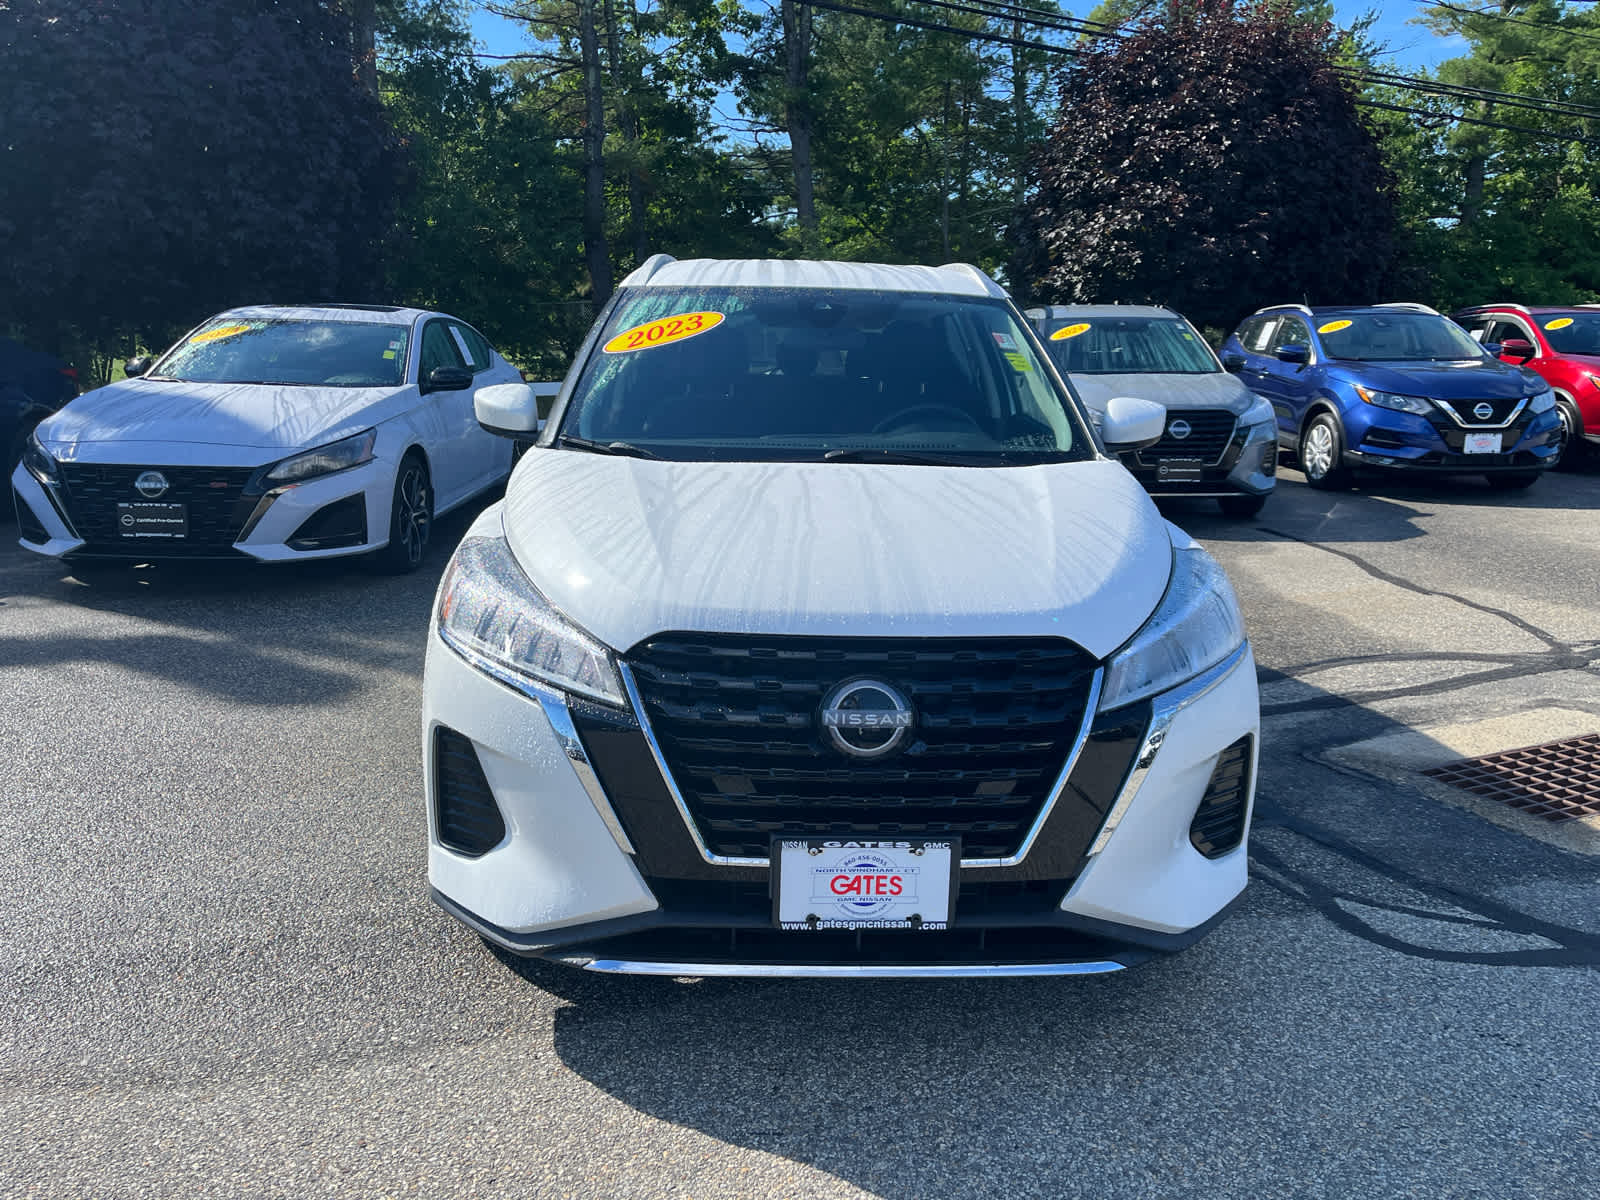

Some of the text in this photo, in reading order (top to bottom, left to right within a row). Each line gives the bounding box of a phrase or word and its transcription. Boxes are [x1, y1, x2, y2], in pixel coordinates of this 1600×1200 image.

[627, 314, 703, 349] 2023
[824, 712, 912, 725] NISSAN
[781, 841, 808, 849] NISSAN
[823, 841, 912, 849] GATES
[830, 874, 903, 896] GATES
[781, 920, 947, 931] www. gatesgmcnissan .com
